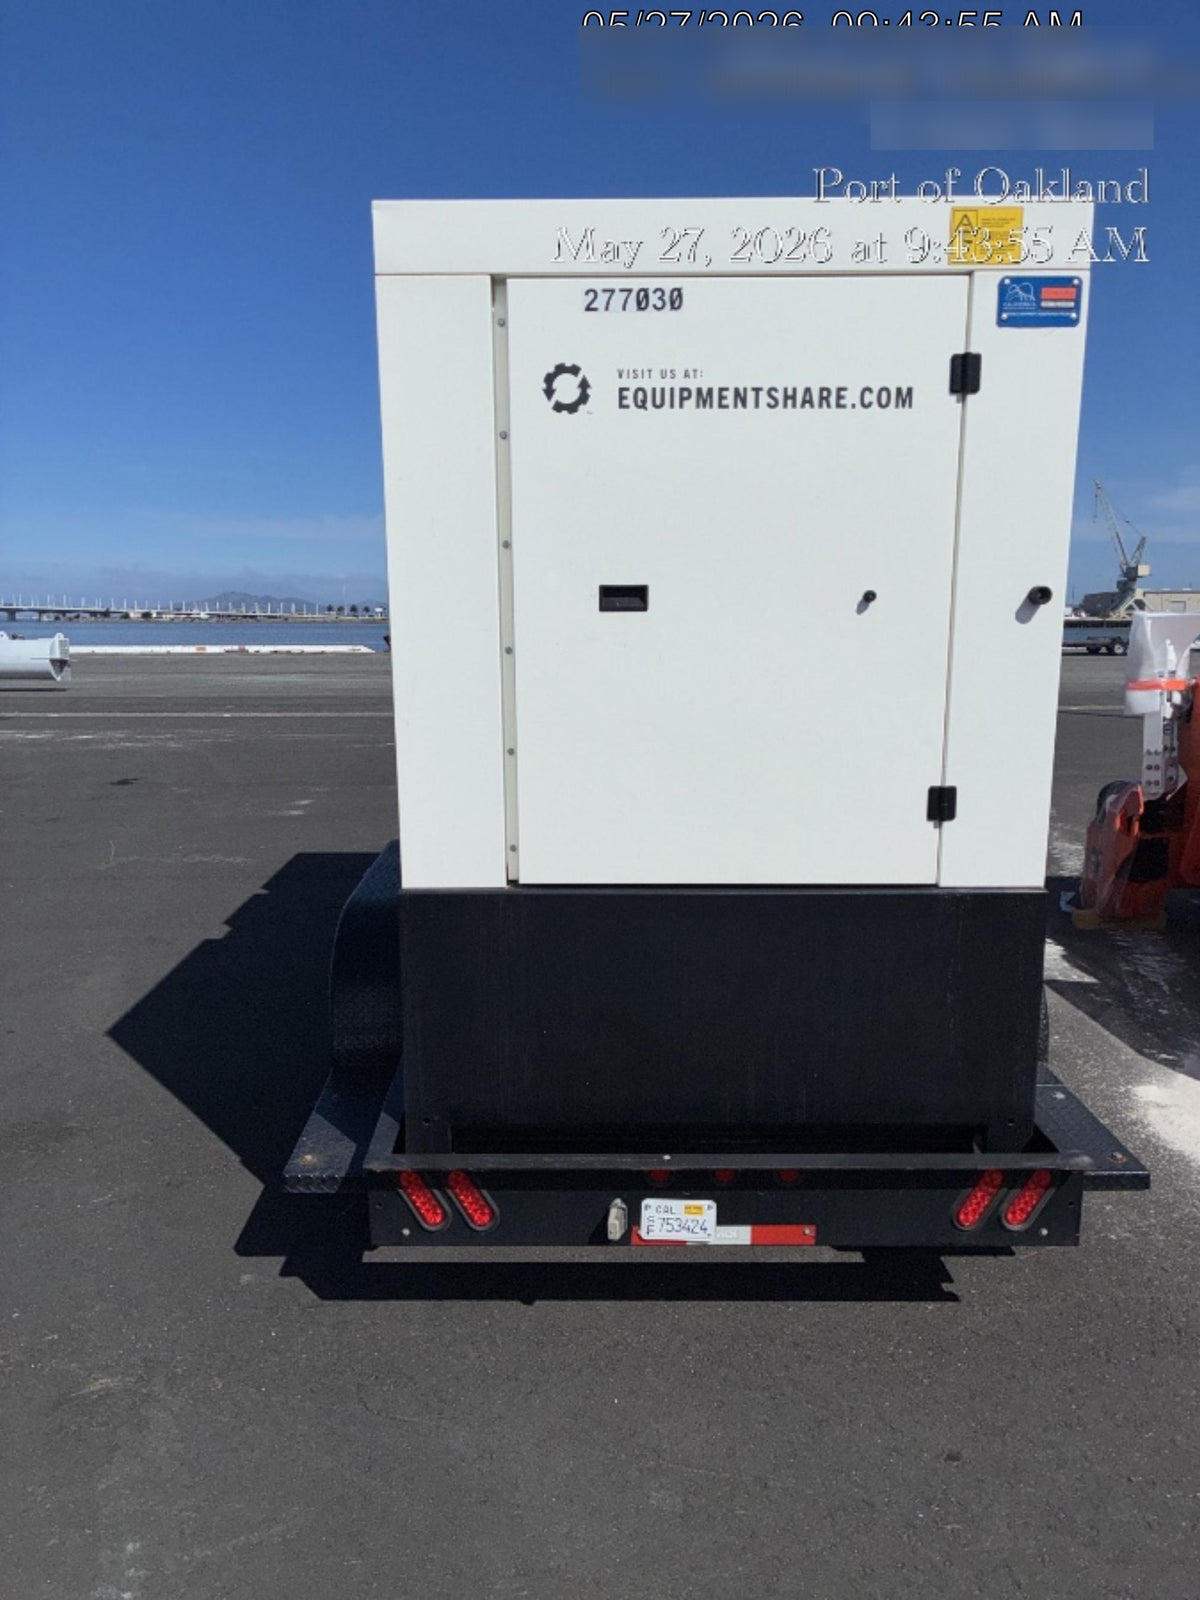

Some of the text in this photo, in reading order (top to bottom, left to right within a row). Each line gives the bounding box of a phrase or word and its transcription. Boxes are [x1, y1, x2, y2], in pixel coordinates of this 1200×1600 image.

[584, 287, 684, 312] 277030
[616, 368, 704, 379] VISIT US AT:
[617, 386, 914, 411] EQUIPMENTSHARE.COM
